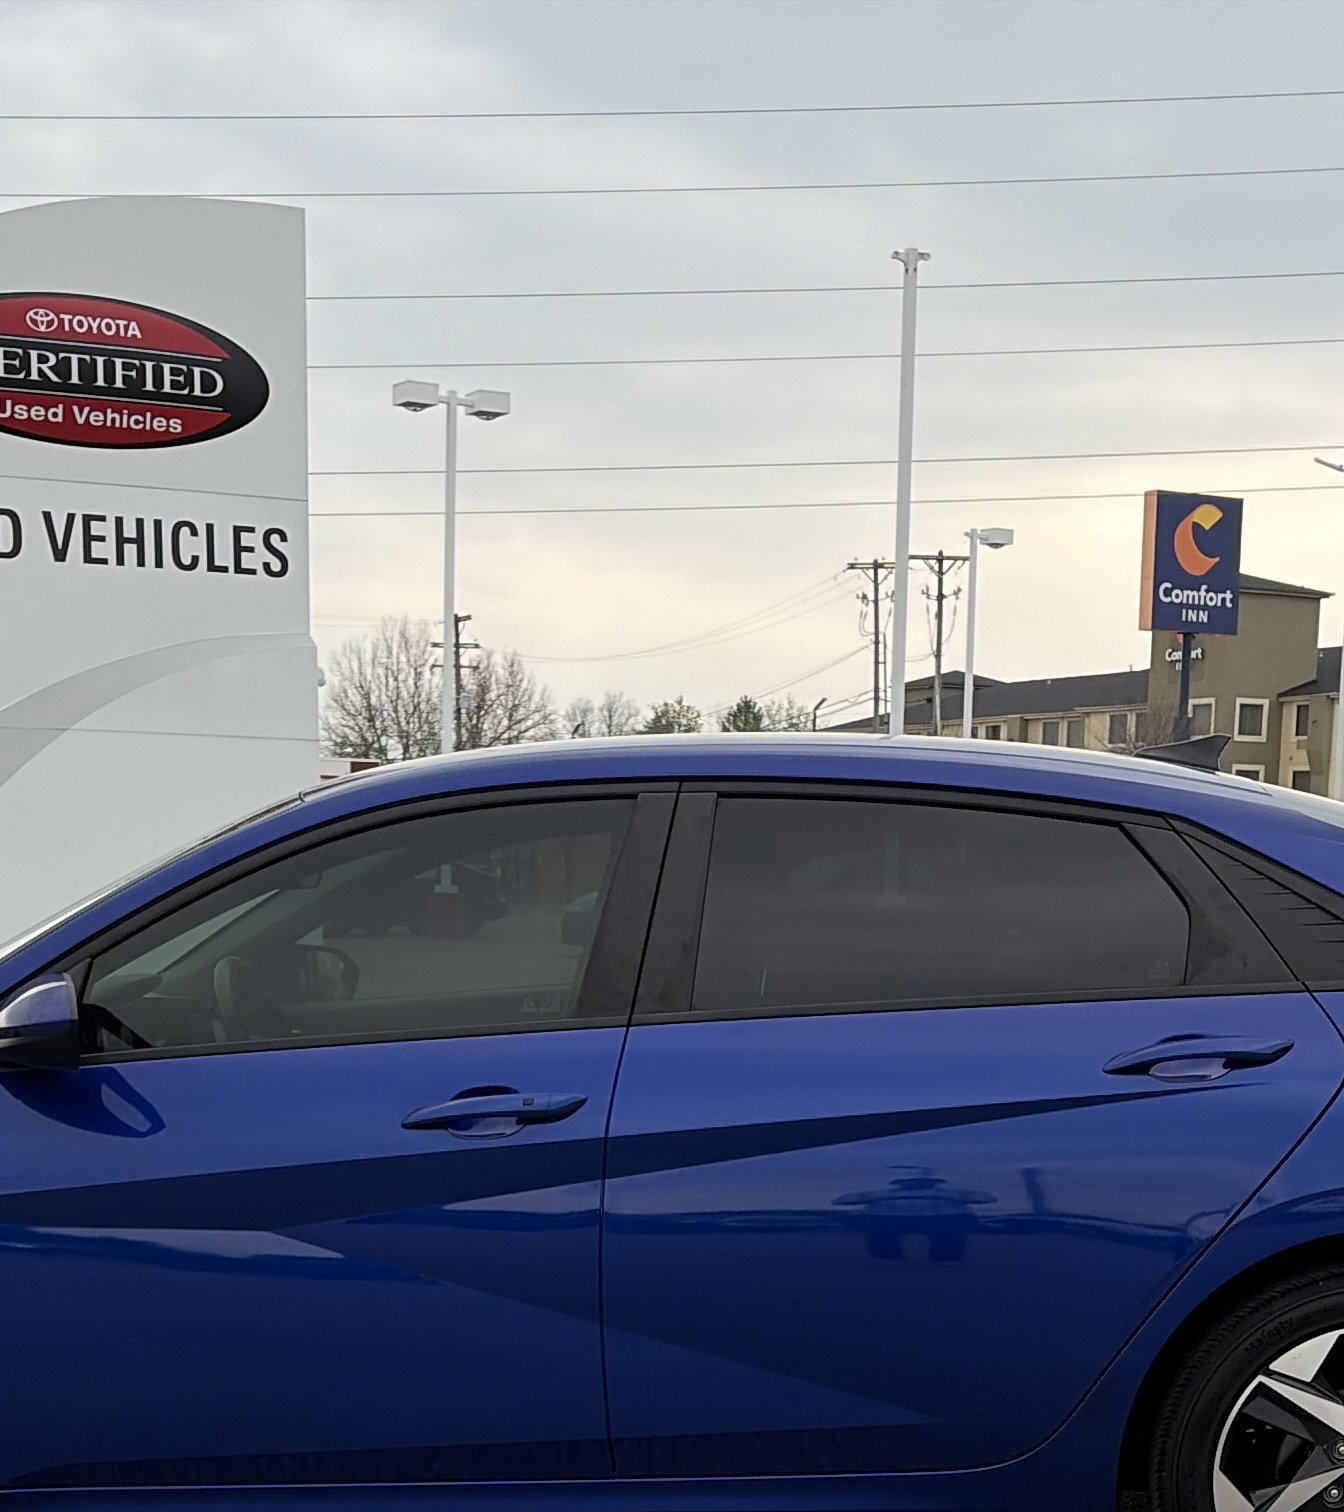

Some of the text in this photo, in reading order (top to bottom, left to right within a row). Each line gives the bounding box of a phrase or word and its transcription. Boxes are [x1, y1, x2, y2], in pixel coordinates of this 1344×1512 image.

[59, 313, 142, 339] TOYOTA
[71, 405, 184, 434] Vehicles
[41, 510, 290, 578] VEHICLES
[1158, 582, 1234, 608] Comfort
[1181, 608, 1209, 624] INN
